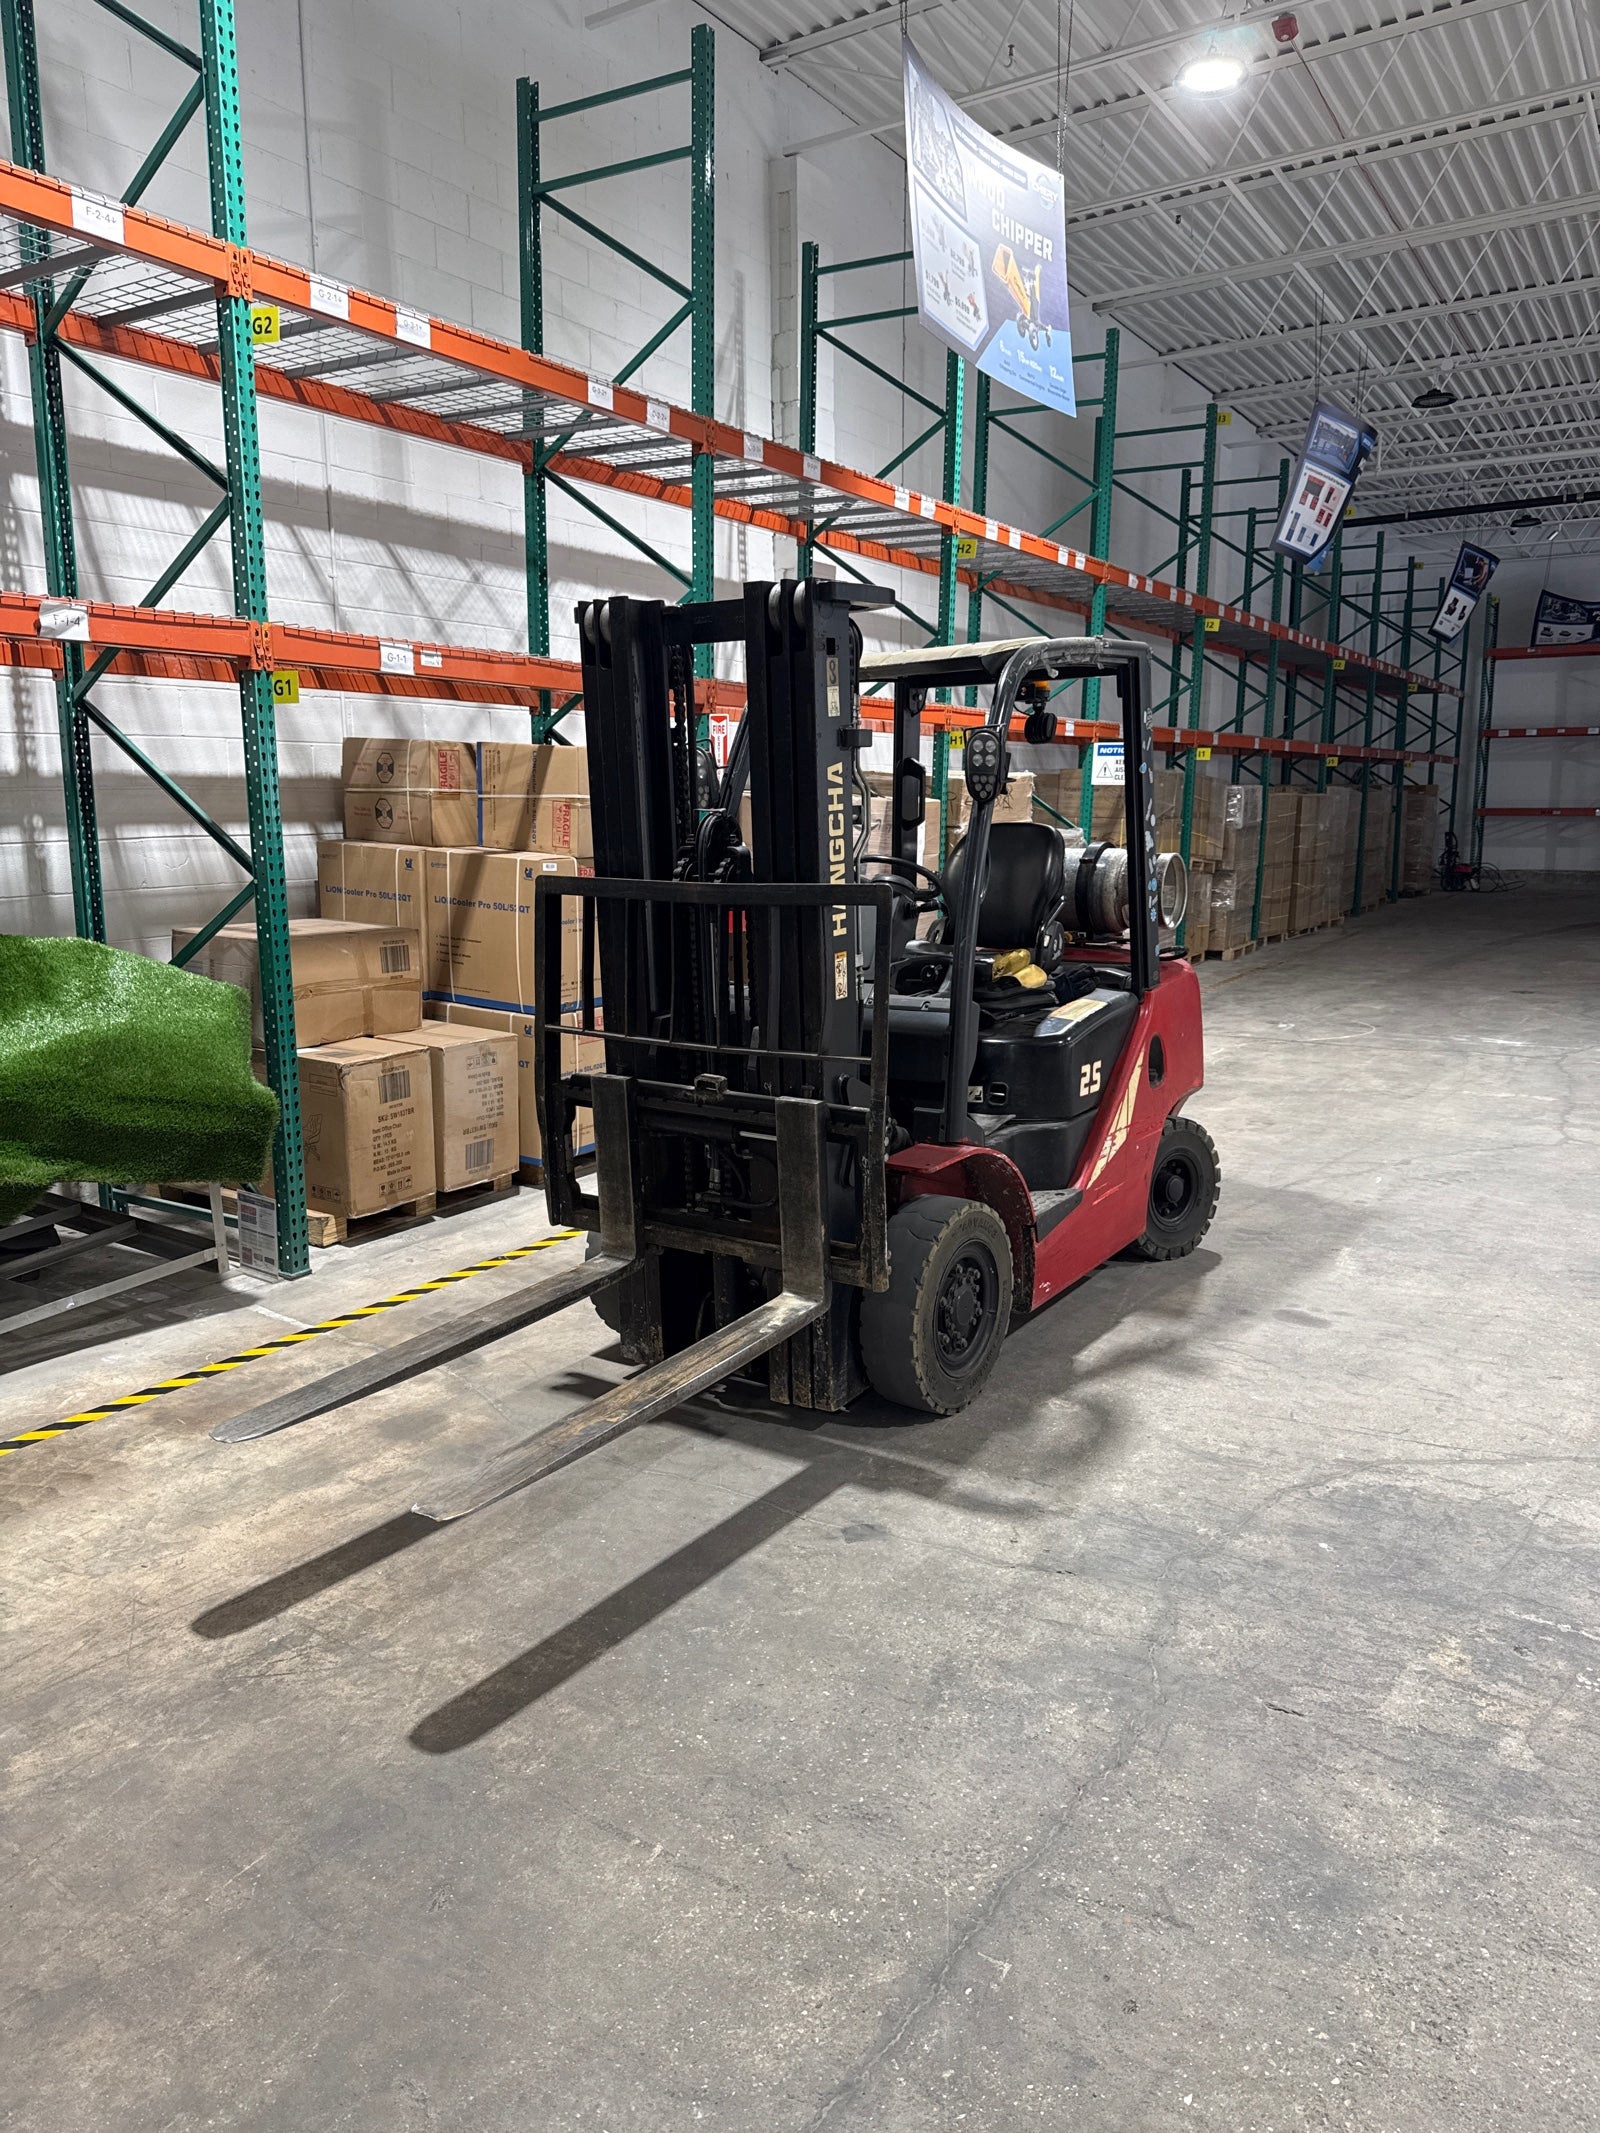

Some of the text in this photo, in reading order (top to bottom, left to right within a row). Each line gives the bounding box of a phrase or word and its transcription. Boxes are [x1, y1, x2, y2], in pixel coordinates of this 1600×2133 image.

[86, 206, 111, 223] F-2-4
[992, 208, 1053, 261] CHIPPER
[252, 316, 272, 334] G2
[957, 544, 971, 554] H2
[53, 614, 80, 626] F-1-4
[387, 652, 407, 664] G-1-1
[273, 679, 292, 696] G1
[713, 725, 725, 734] FIRE
[950, 735, 963, 745] H1
[440, 751, 448, 789] FRAGILE
[563, 803, 571, 846] FRAGILE
[827, 762, 848, 937] HNGCHA
[366, 889, 377, 898] Pro
[477, 900, 491, 909] Pro
[1080, 1060, 1101, 1097] 25
